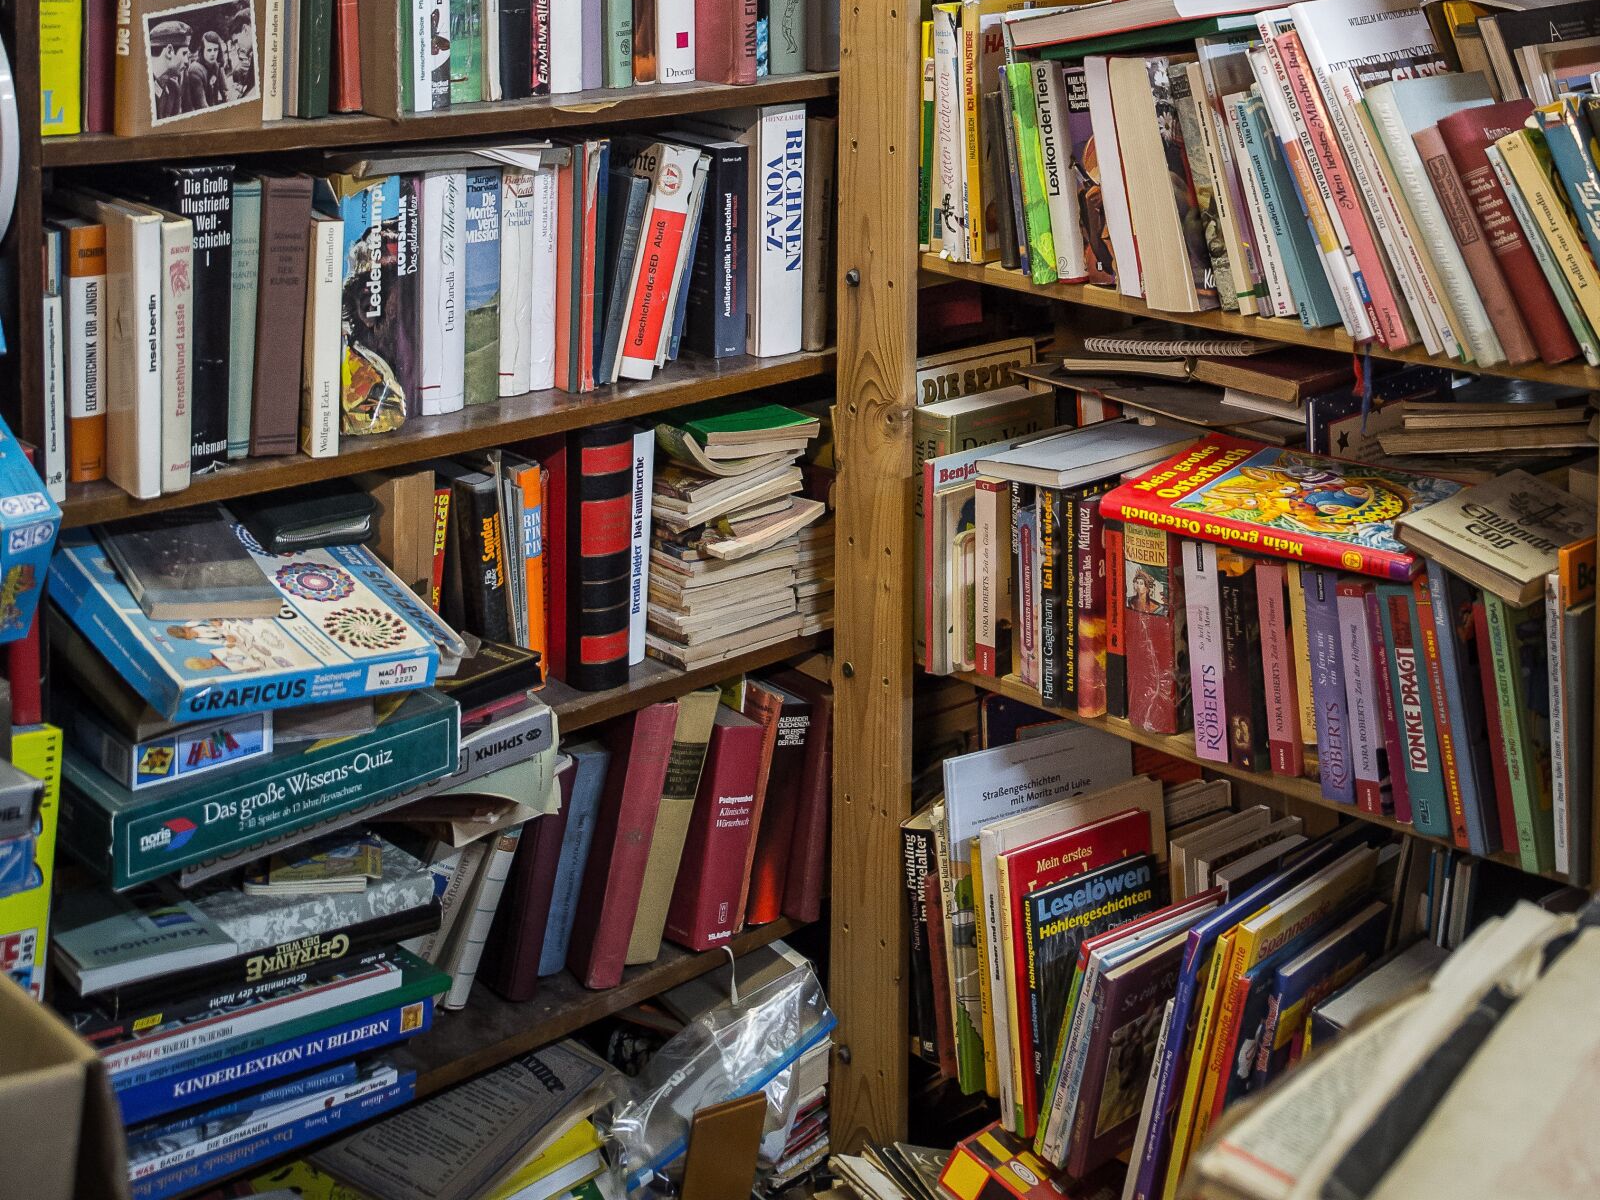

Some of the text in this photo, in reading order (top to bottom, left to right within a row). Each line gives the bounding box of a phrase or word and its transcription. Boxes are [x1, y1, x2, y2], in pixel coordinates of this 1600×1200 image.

[272, 14, 280, 36] Juden
[273, 0, 281, 12] im
[116, 34, 131, 56] Die
[271, 38, 279, 53] der
[744, 21, 757, 59] HANS
[269, 54, 279, 97] Geschichte
[965, 30, 977, 160] HAUSTIER-BUCH ICH MAG HAUSTIERE
[1036, 67, 1061, 197] Lexikon der Tiere
[1259, 23, 1332, 201] WAS IST WAS BAND 54 DIE EISENBAHN
[1235, 104, 1282, 237] Friedrich Dürrenmatt Alte Dame
[1317, 131, 1342, 171] liebstes
[181, 195, 230, 215] Illustrierte
[183, 176, 229, 195] Die Große
[482, 192, 497, 207] Die
[765, 154, 784, 252] VON A-Z
[785, 127, 804, 273] RECHNEN
[1331, 174, 1355, 210] Mein
[465, 205, 498, 220] Monte-
[1534, 191, 1559, 233] Freundin
[324, 226, 335, 284] Familienfoto
[465, 229, 499, 244] Mission
[723, 192, 733, 318] Ausländerpolitik in Deutschland
[634, 220, 667, 347] Geschichte SED Abriß
[1565, 254, 1589, 289] Endlich
[85, 281, 98, 413] ELEKTROTECHNIK JUNGEN
[148, 293, 157, 373] insel berlin
[175, 303, 186, 417] Fernsehhund Lassie
[921, 371, 960, 405] DIE
[320, 379, 331, 454] Wolfgang Eckert
[1132, 444, 1221, 492] Mein großes
[1156, 447, 1253, 500] Osterbuch
[432, 493, 450, 556] SPIEL
[631, 455, 646, 615] Brenda Jagger Das Familienerbe
[1042, 490, 1053, 535] wieder
[1120, 505, 1304, 557] Mein großes Osterbuch
[481, 517, 494, 564] Sonder
[1065, 501, 1075, 607] Rosengarten versprochen
[1125, 547, 1166, 564] KAISERIN
[981, 576, 990, 638] NORA ROBERTS
[1043, 598, 1055, 700] Hartmut Gagelmann
[188, 679, 307, 714] GRAFICUS
[379, 674, 414, 687] No. 2223
[1197, 712, 1206, 745] NORA
[1201, 664, 1220, 752] ROBERTS
[186, 728, 240, 768] HALMA
[475, 732, 524, 764] SPHINX
[1324, 702, 1347, 792] ROBERTS
[1403, 699, 1429, 773] TONKE
[203, 745, 394, 825] Das große Wissens-Quiz
[981, 772, 1062, 802] Straßengeschichten
[1009, 776, 1092, 807] mit Moritz und Luise
[140, 825, 171, 850] noris
[1036, 844, 1093, 875] Mein erstes
[905, 834, 917, 890] Frühling
[1037, 862, 1151, 922] Leselöwen
[1039, 890, 1153, 940] Höhlengeschichten
[246, 933, 351, 983] GETRÄNKE
[275, 934, 321, 955] DER WELT
[1024, 899, 1037, 990] Höhlengeschichten
[209, 972, 308, 1008] Geheimnisse der Nacht
[1210, 944, 1247, 1075] Spannende Experimente
[172, 1018, 391, 1099] KINDERLEXIKON IN BILDERN
[1033, 1050, 1043, 1076] König
[206, 1121, 269, 1151] DIE GERMANEN
